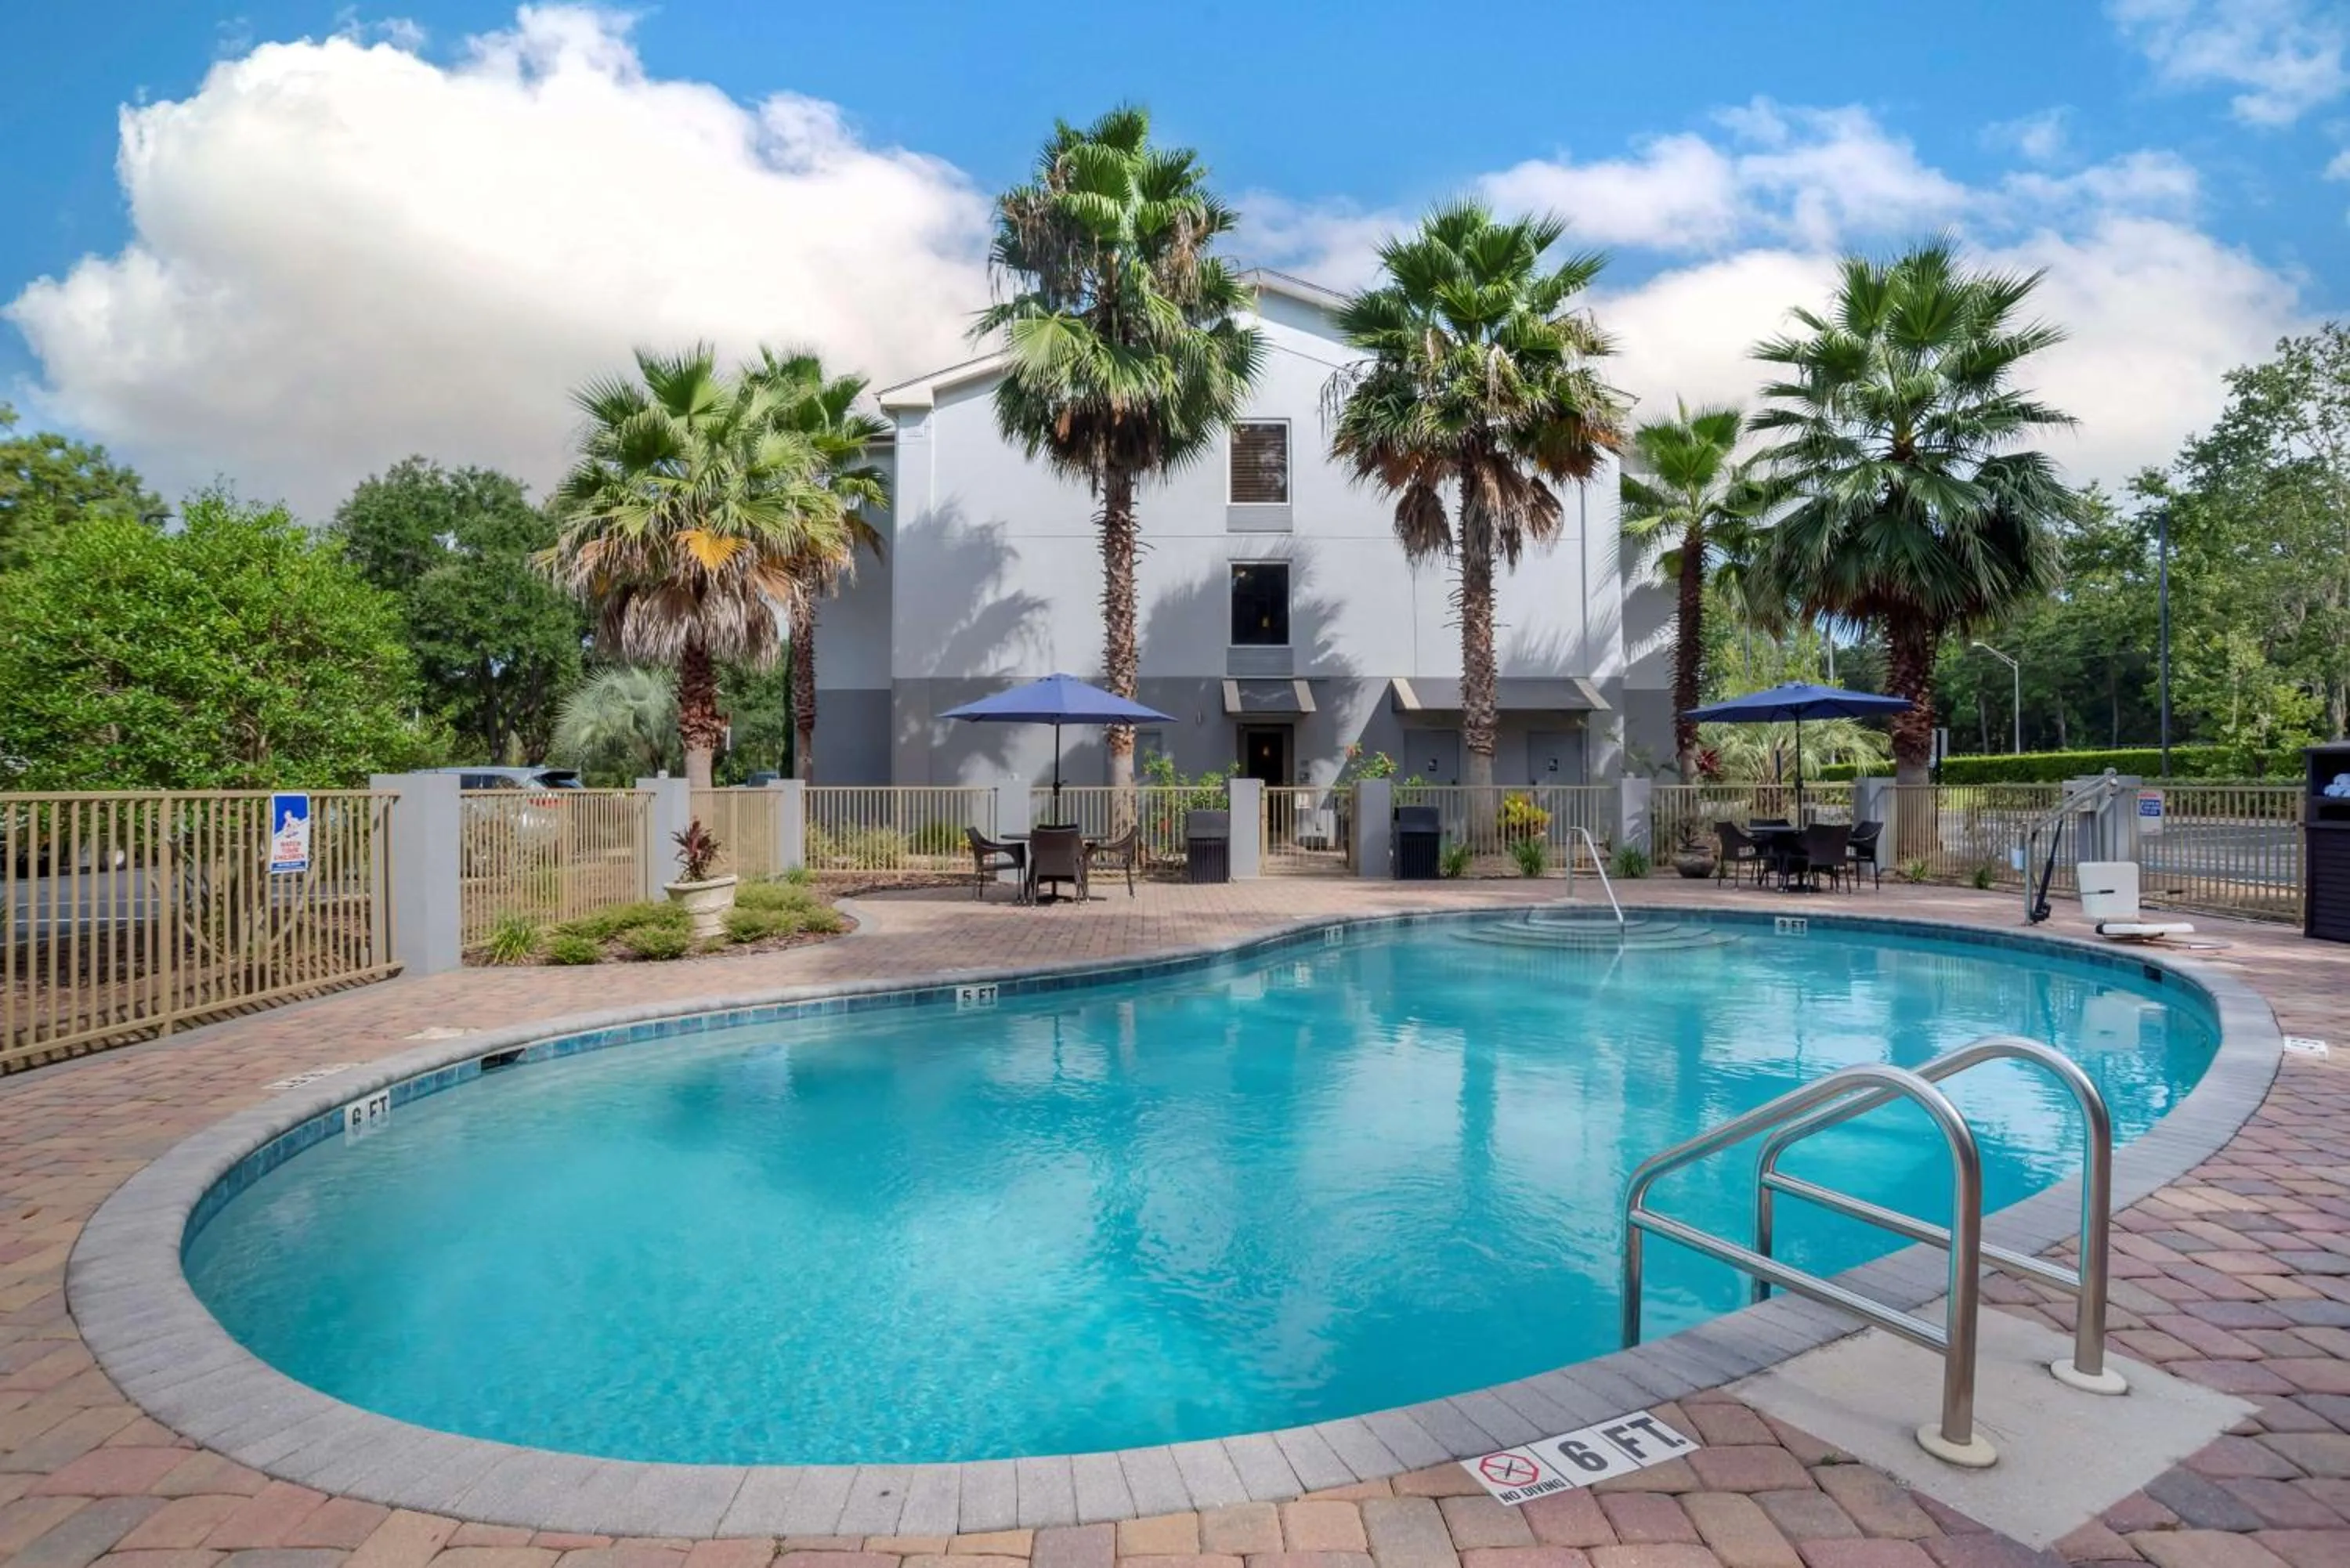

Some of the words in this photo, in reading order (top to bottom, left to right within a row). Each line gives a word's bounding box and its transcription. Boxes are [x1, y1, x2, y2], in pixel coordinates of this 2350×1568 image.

[369, 1094, 389, 1118] FT
[1556, 1440, 1609, 1472] 6
[1499, 1490, 1522, 1503] NO
[1520, 1478, 1567, 1497] DIVING
